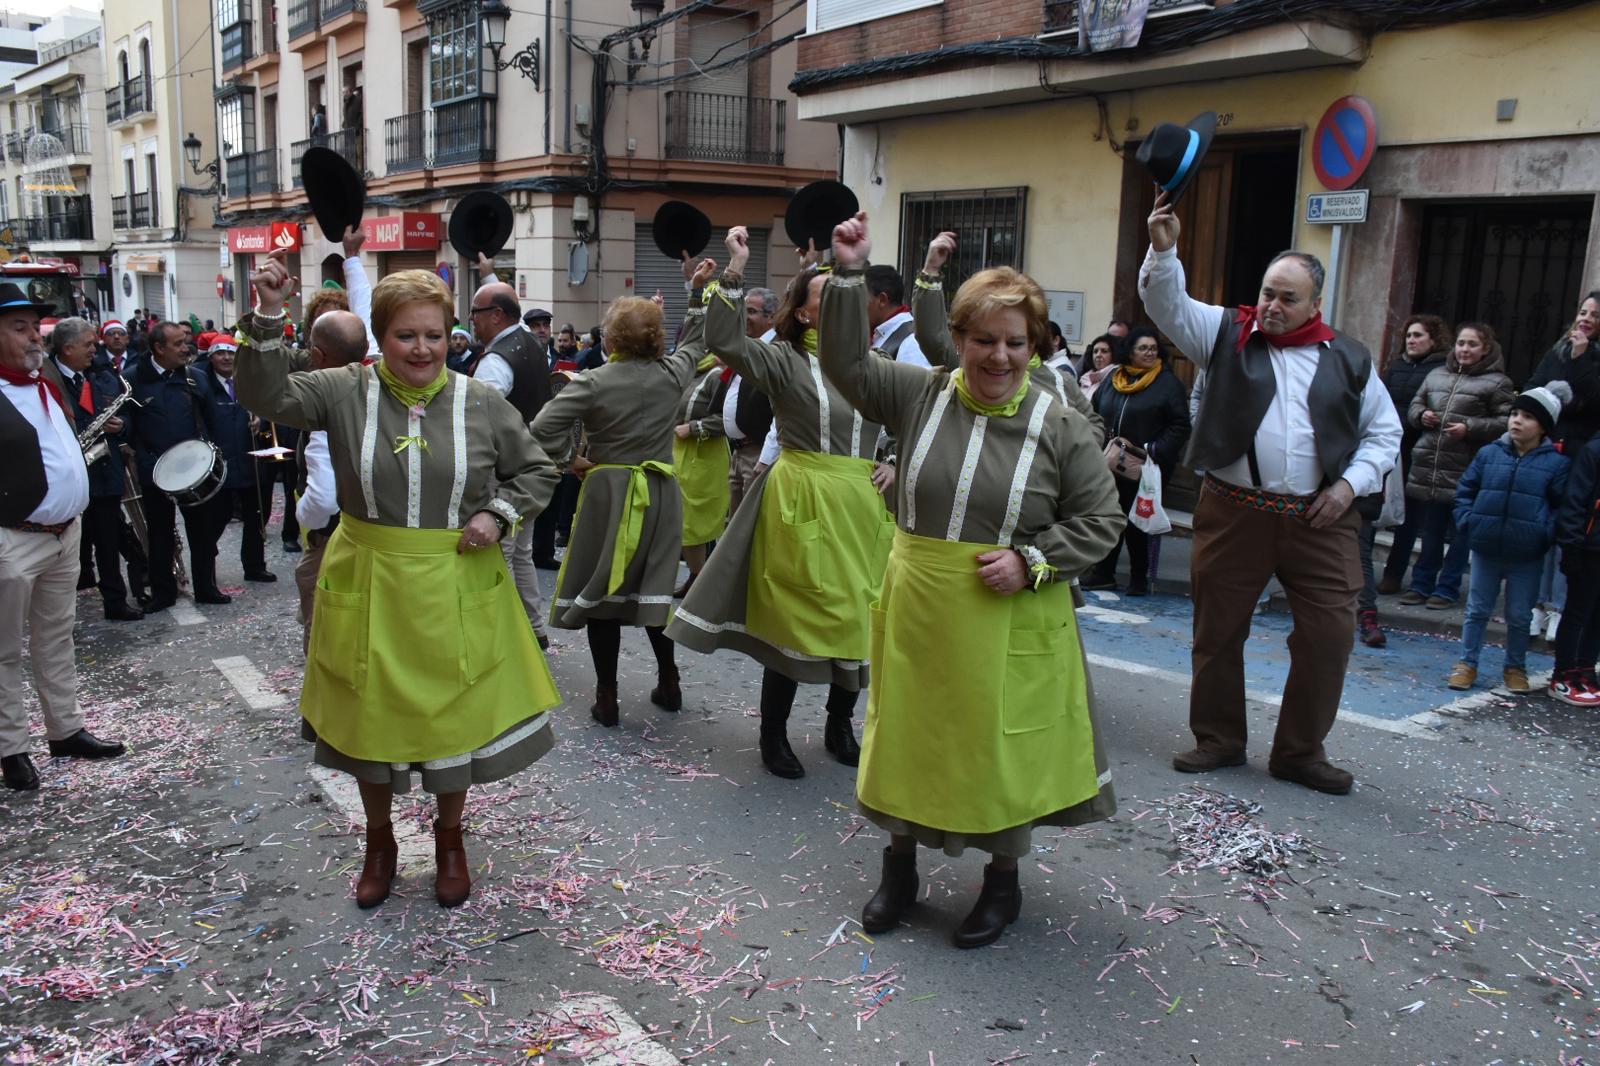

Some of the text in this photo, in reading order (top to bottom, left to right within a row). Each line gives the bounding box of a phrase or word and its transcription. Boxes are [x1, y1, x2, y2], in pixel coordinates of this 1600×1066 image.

[1327, 195, 1361, 207] RESERVADO
[406, 230, 435, 238] MAPFRE
[241, 234, 265, 249] Santander
